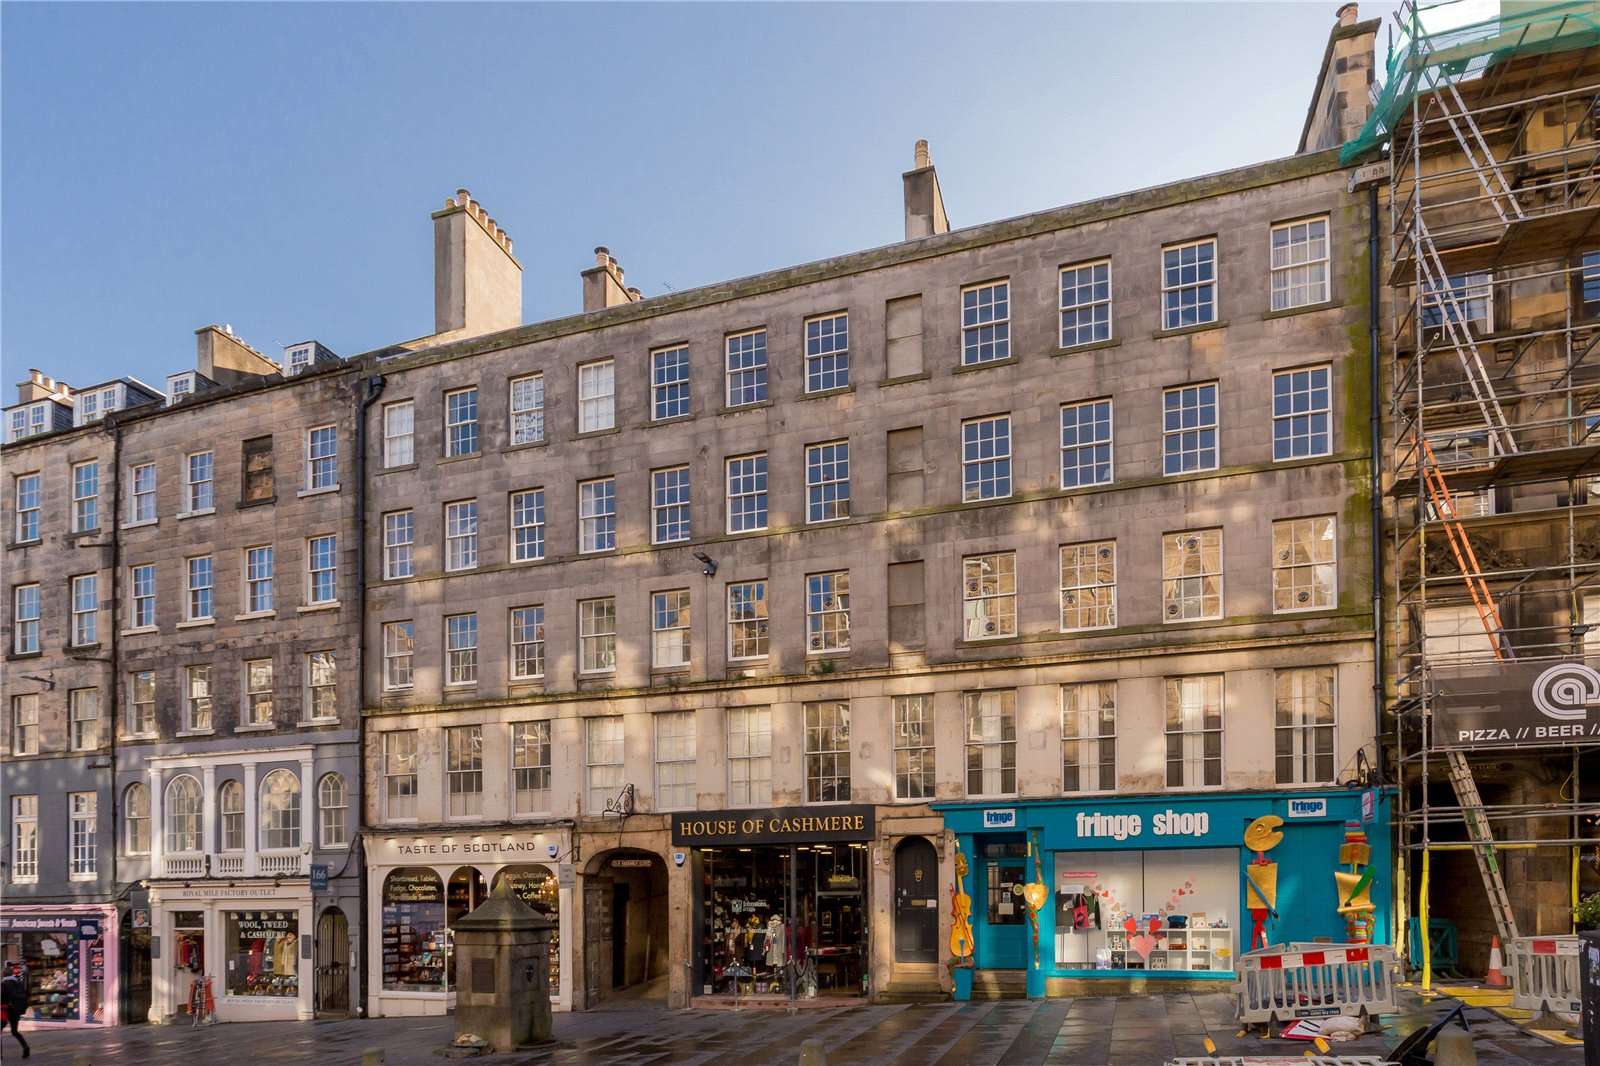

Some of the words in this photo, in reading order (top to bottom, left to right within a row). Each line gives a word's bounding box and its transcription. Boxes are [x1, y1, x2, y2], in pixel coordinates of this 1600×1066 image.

[1459, 728, 1510, 741] PIZZA
[1535, 724, 1584, 737] BEER
[1292, 801, 1323, 812] fringe
[986, 811, 1013, 823] fringe
[680, 820, 737, 836] HOUSE
[742, 819, 764, 834] OF
[769, 815, 865, 833] CASHMERE
[1076, 812, 1142, 840] fringe
[1153, 809, 1209, 836] shop
[398, 845, 437, 854] TASTE
[441, 844, 459, 853] OF
[463, 842, 535, 853] SCOTLAND
[312, 869, 326, 880] 166
[249, 888, 276, 896] OUTLET
[238, 920, 261, 929] WOOL,
[262, 920, 289, 929] TWEED
